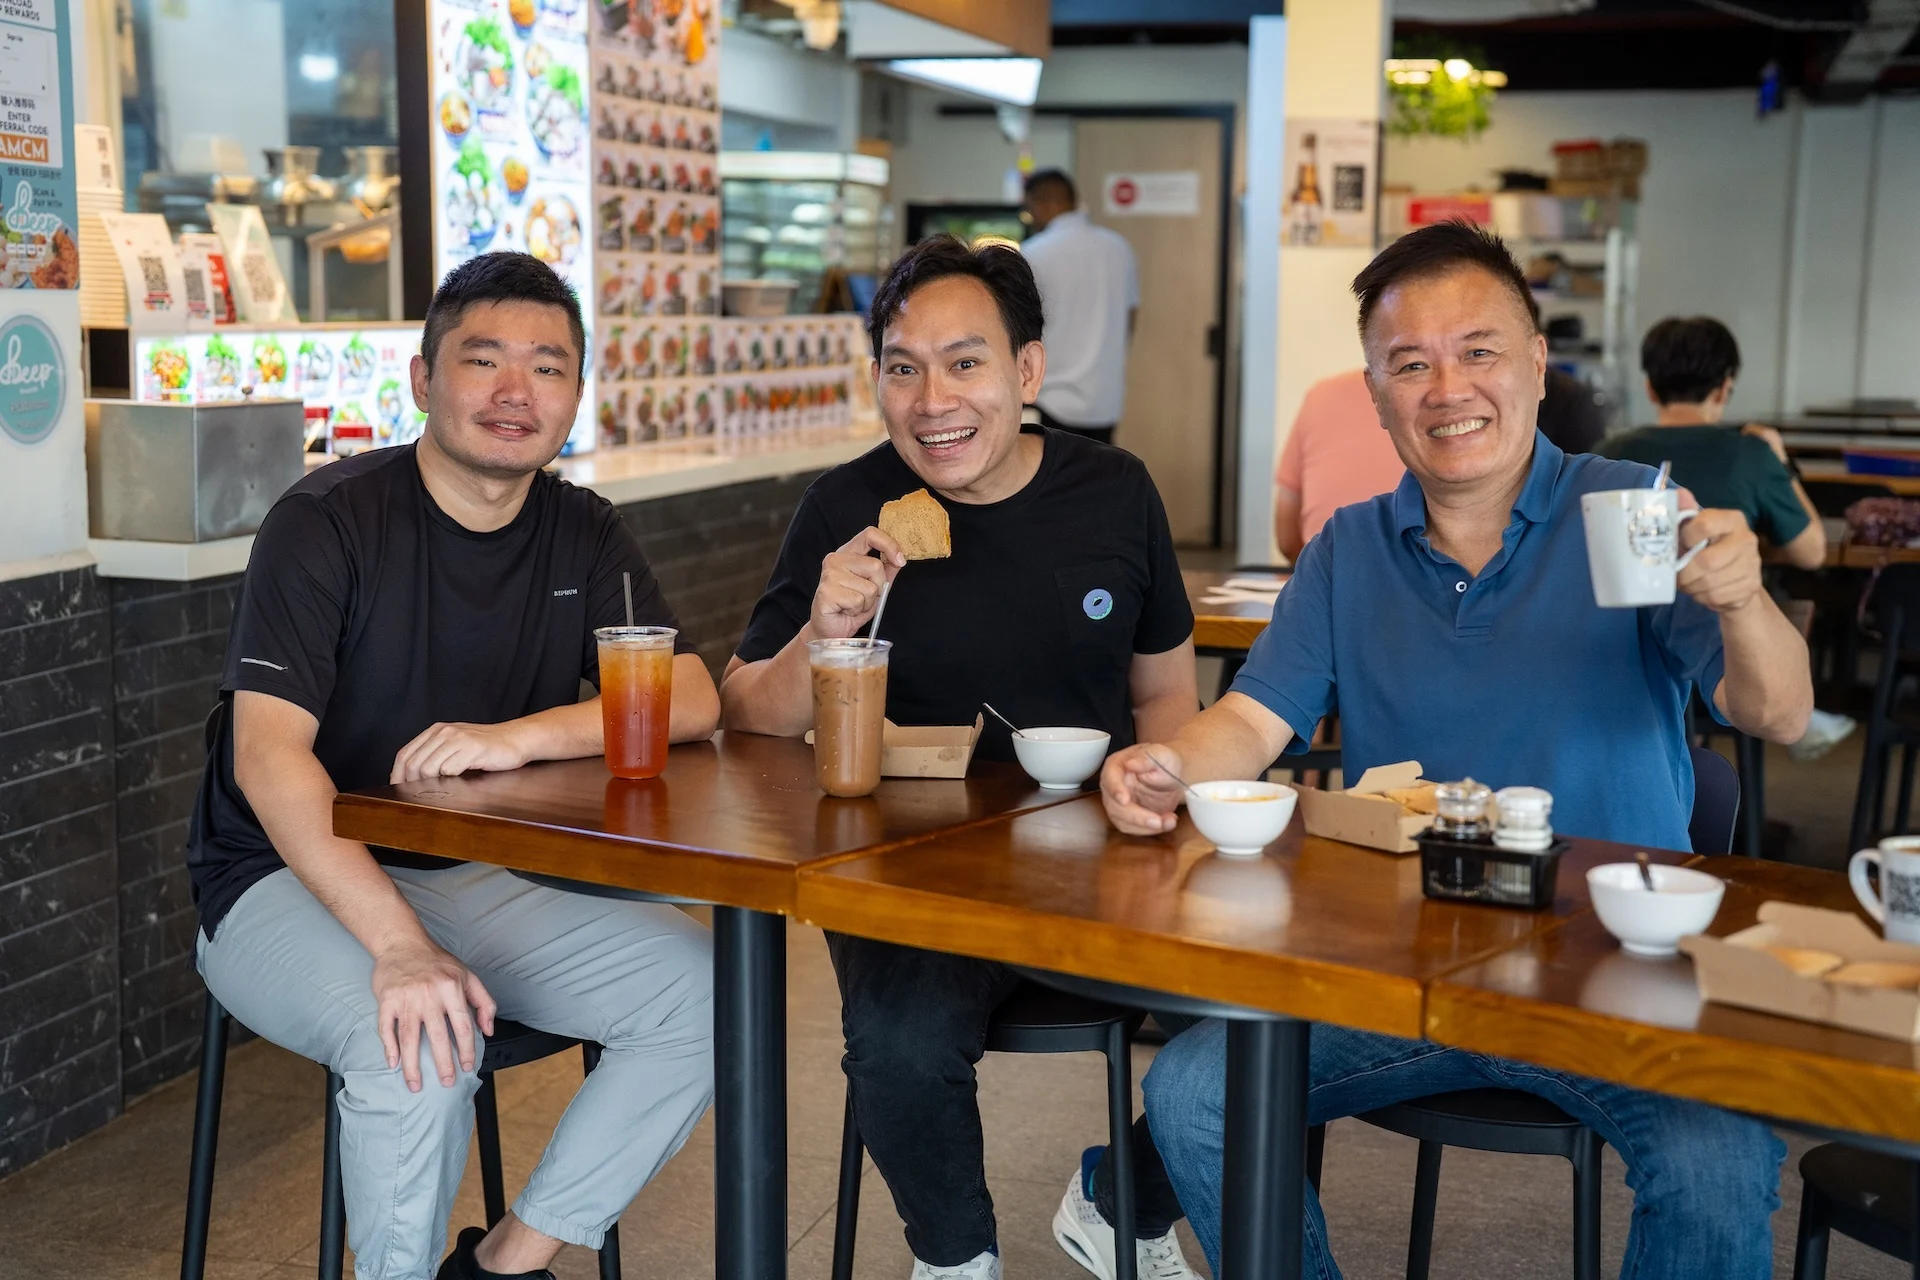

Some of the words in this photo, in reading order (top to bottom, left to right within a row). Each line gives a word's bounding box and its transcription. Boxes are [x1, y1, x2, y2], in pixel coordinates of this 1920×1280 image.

[5, 5, 40, 20] REWARDS
[8, 111, 31, 122] ENTER
[28, 124, 48, 136] CODE
[21, 167, 37, 177] BEEP
